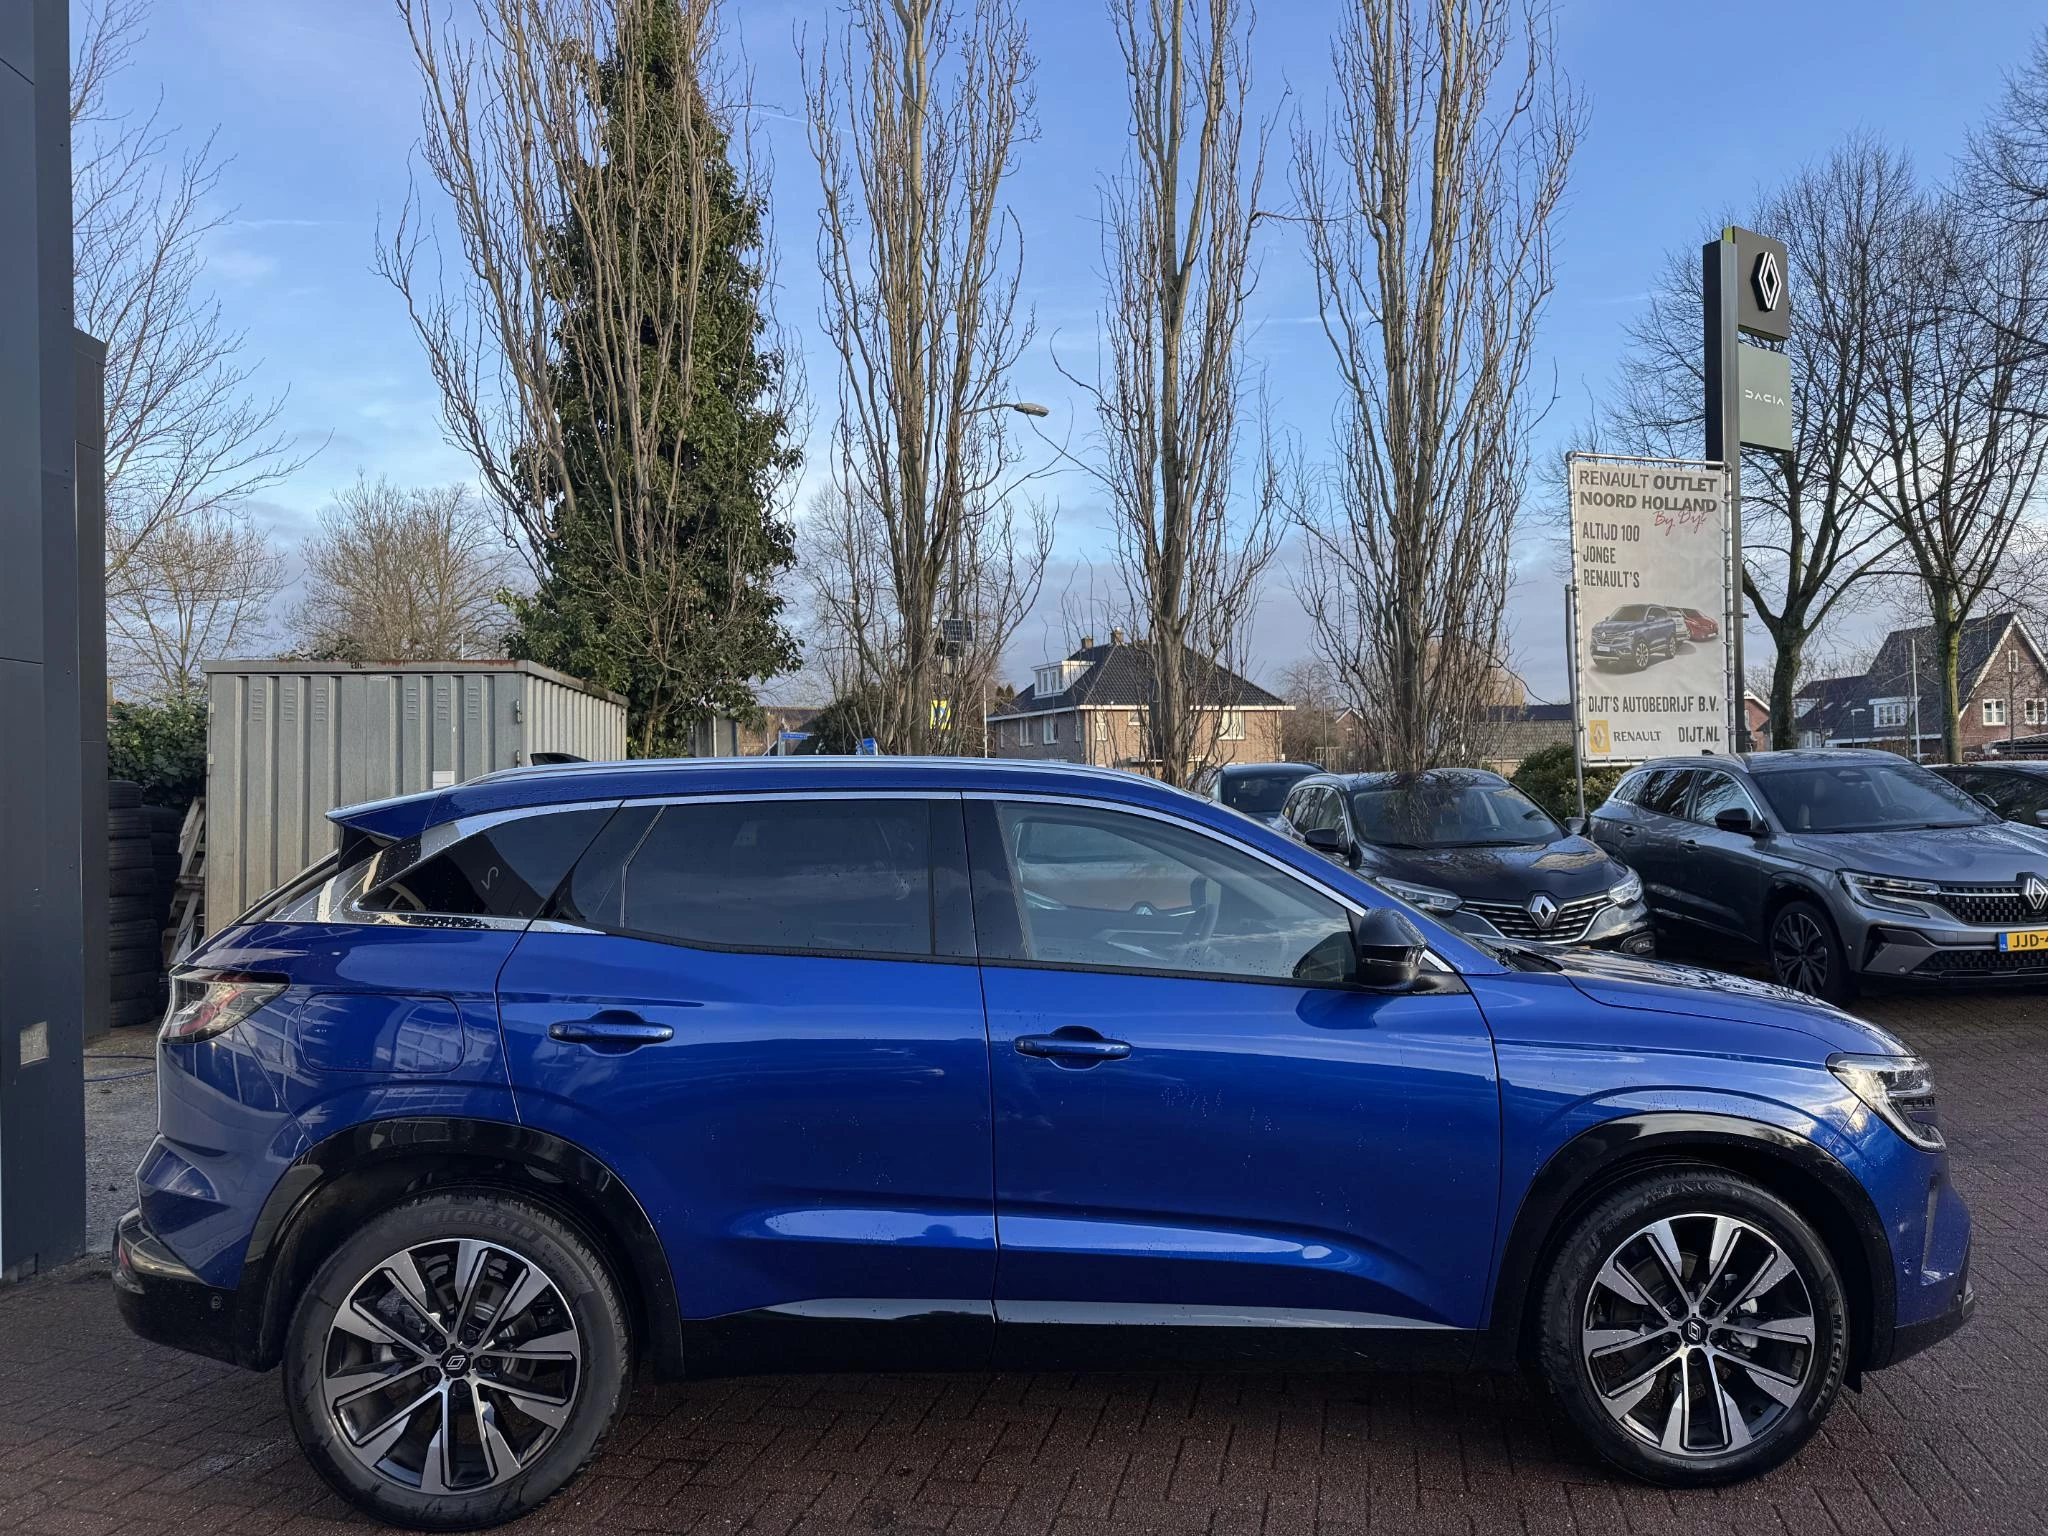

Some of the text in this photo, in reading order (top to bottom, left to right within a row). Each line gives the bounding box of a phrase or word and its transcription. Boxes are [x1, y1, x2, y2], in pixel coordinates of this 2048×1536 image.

[1745, 390, 1785, 406] DACIA
[1580, 470, 1717, 492] RENAULT OUTLET
[1580, 491, 1718, 513] NOORD HOLLAND
[1582, 521, 1640, 542] ALTIJD 100
[1653, 511, 1675, 536] By
[1582, 545, 1616, 564] JONGE
[1583, 569, 1640, 588] RENAULT'S
[1588, 695, 1719, 713] DIJT'S AUTOBEDRIJF B.V.
[1613, 731, 1662, 742] RENAULT
[1678, 726, 1720, 743] DIJT.NL
[430, 1210, 535, 1239] MICHELIN
